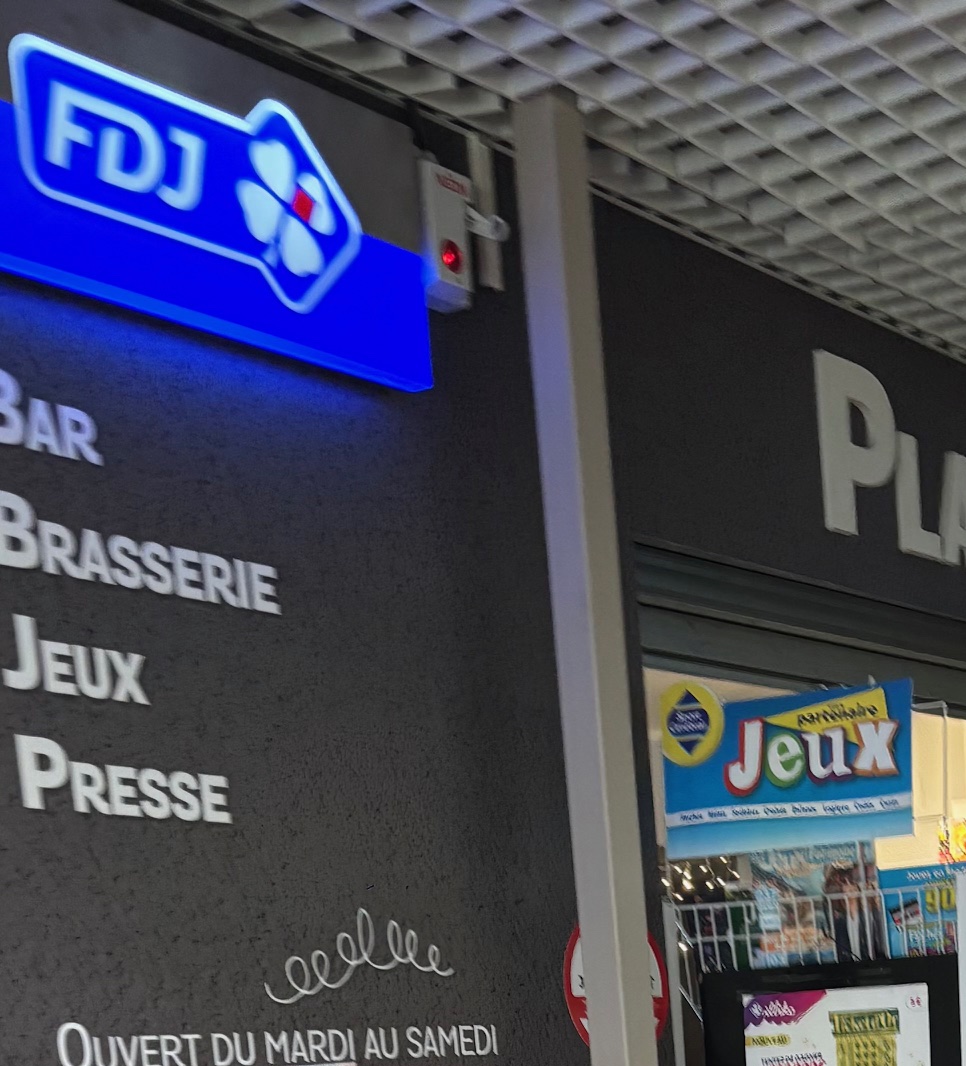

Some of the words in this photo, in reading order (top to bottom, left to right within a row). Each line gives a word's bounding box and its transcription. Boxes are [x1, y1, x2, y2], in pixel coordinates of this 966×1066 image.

[43, 78, 206, 211] FDJ
[2, 612, 150, 705] JEUX
[13, 734, 233, 825] PRESSE
[723, 717, 899, 796] Jeux
[211, 1032, 256, 1066] DU
[265, 1028, 356, 1063] MARDI
[364, 1027, 399, 1060] AU
[407, 1024, 498, 1057] SAMEDI
